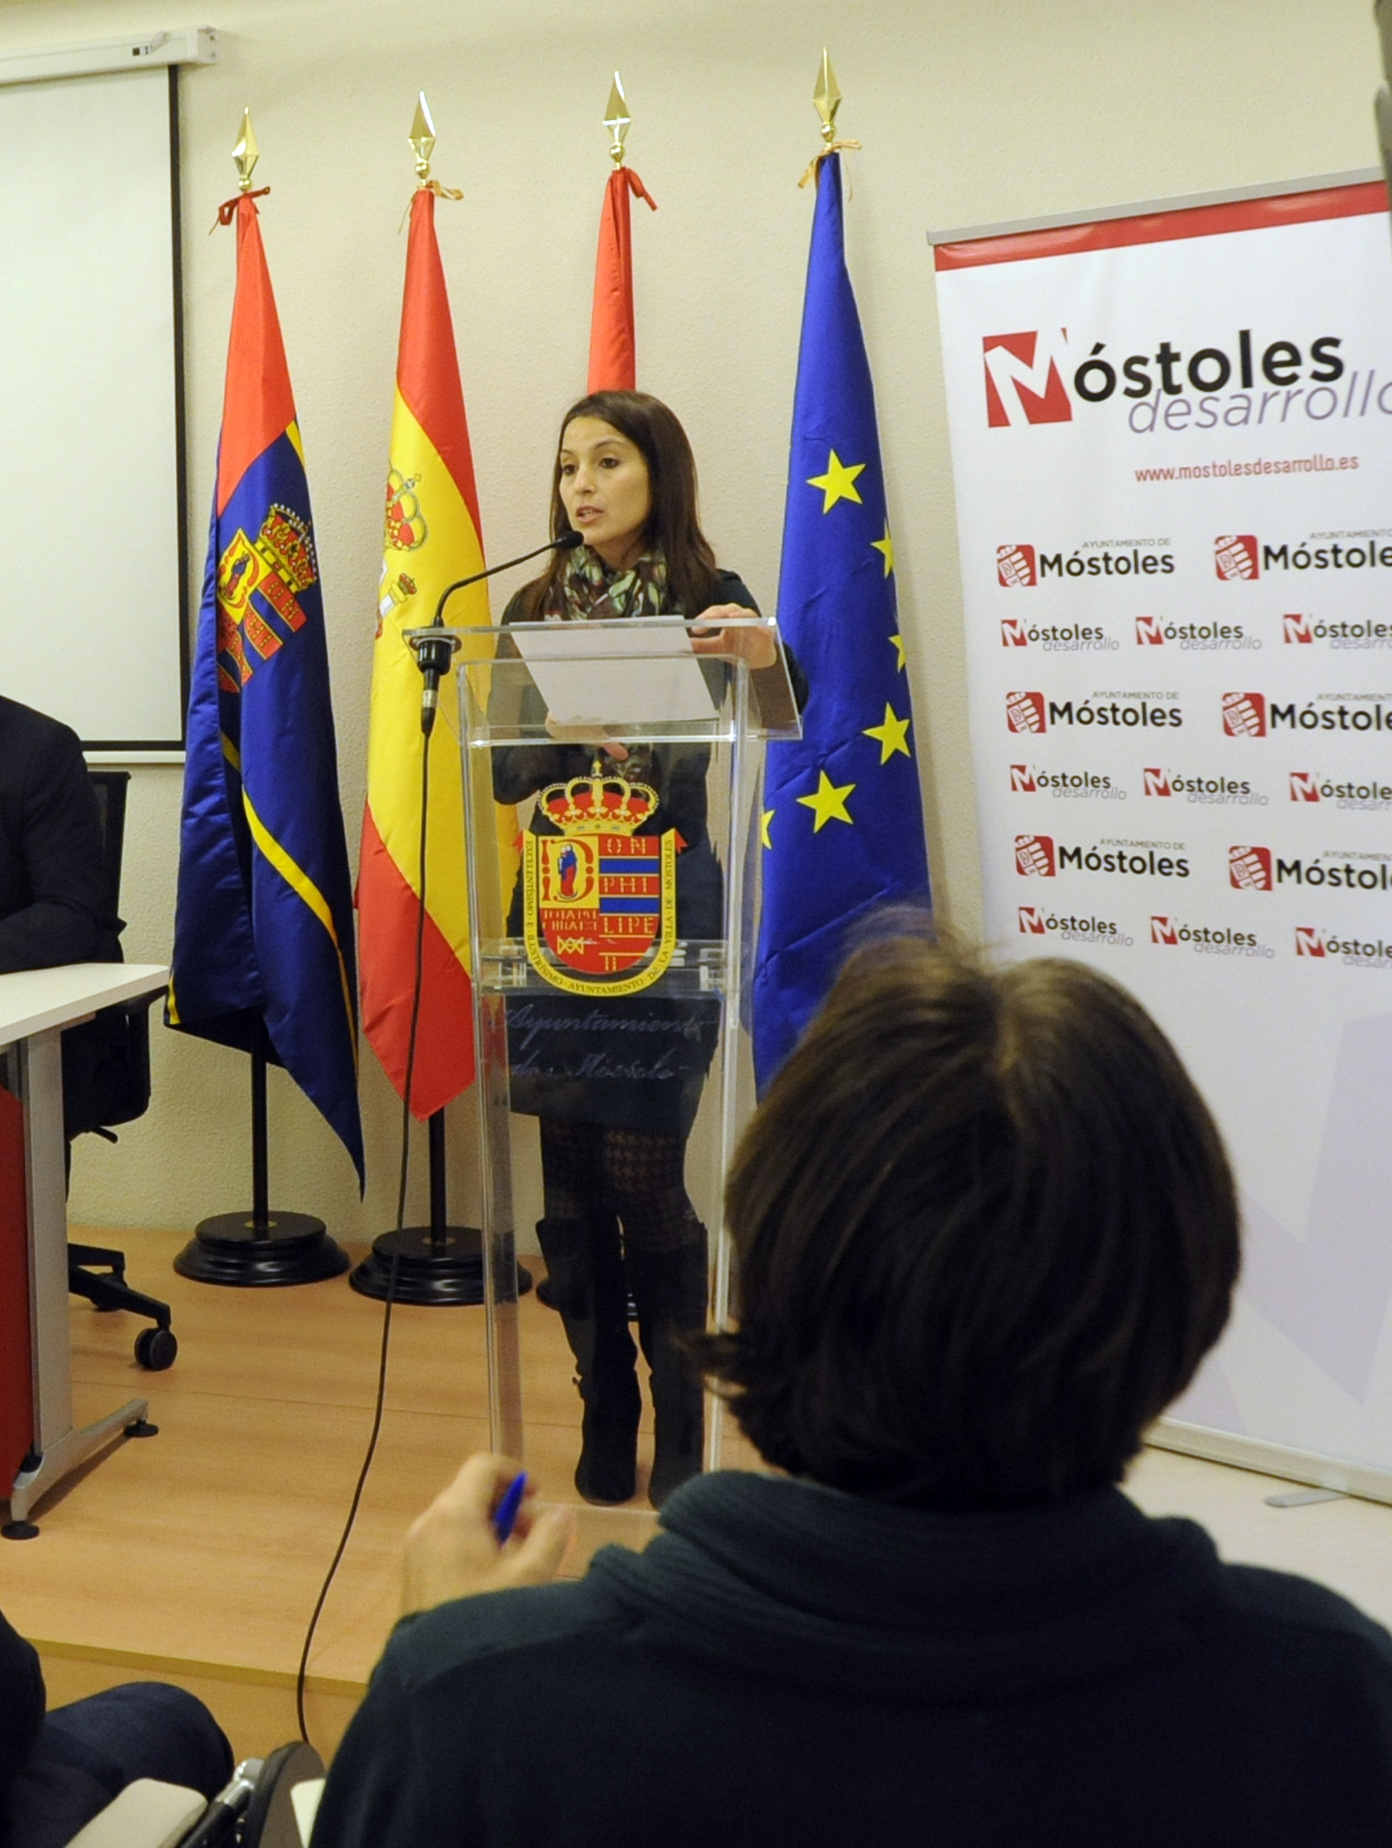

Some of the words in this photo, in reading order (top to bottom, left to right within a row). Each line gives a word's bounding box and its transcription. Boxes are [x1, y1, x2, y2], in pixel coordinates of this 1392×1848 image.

[1135, 454, 1360, 482] www.mostolesdesarrollo.es
[1082, 538, 1155, 549] AYUNTAMIENTO
[1157, 537, 1171, 547] DE
[1262, 540, 1392, 570] Móstole
[1039, 549, 1175, 578] Móstoles
[1283, 613, 1392, 644] Móstole
[1092, 691, 1164, 701] AYUNTAMIENTO
[1165, 691, 1179, 701] DE
[1048, 699, 1183, 728] Móstoles
[1270, 702, 1392, 731] Móstol
[1290, 772, 1392, 803] Móstole
[1099, 837, 1171, 850] AYUNTAMIENTO
[1173, 841, 1186, 851] DE
[1058, 845, 1190, 878] Móstoles
[1276, 858, 1392, 891] Móstol
[568, 978, 644, 994] AYUNTAMIENTO
